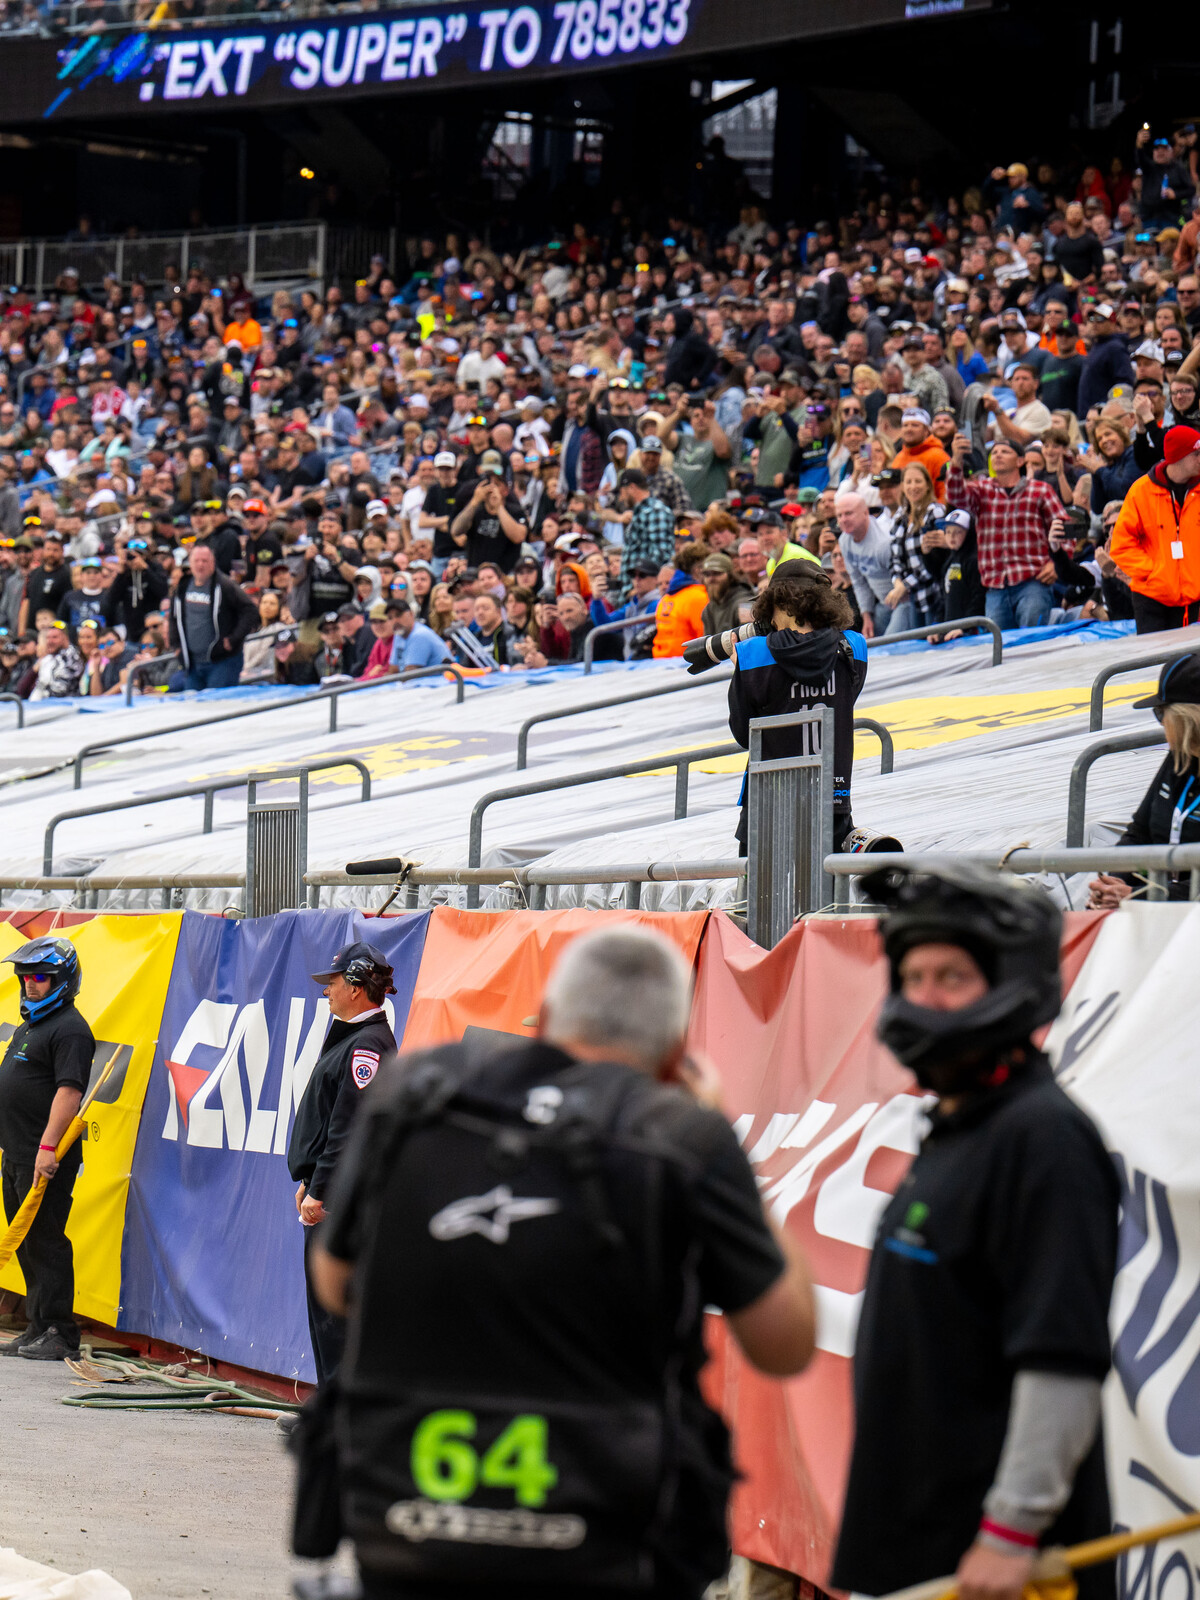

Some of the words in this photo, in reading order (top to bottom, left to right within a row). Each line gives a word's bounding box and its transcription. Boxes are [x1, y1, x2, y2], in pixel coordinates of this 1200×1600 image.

[479, 9, 541, 70] TO
[550, 0, 690, 63] 785833
[409, 1408, 559, 1508] 64
